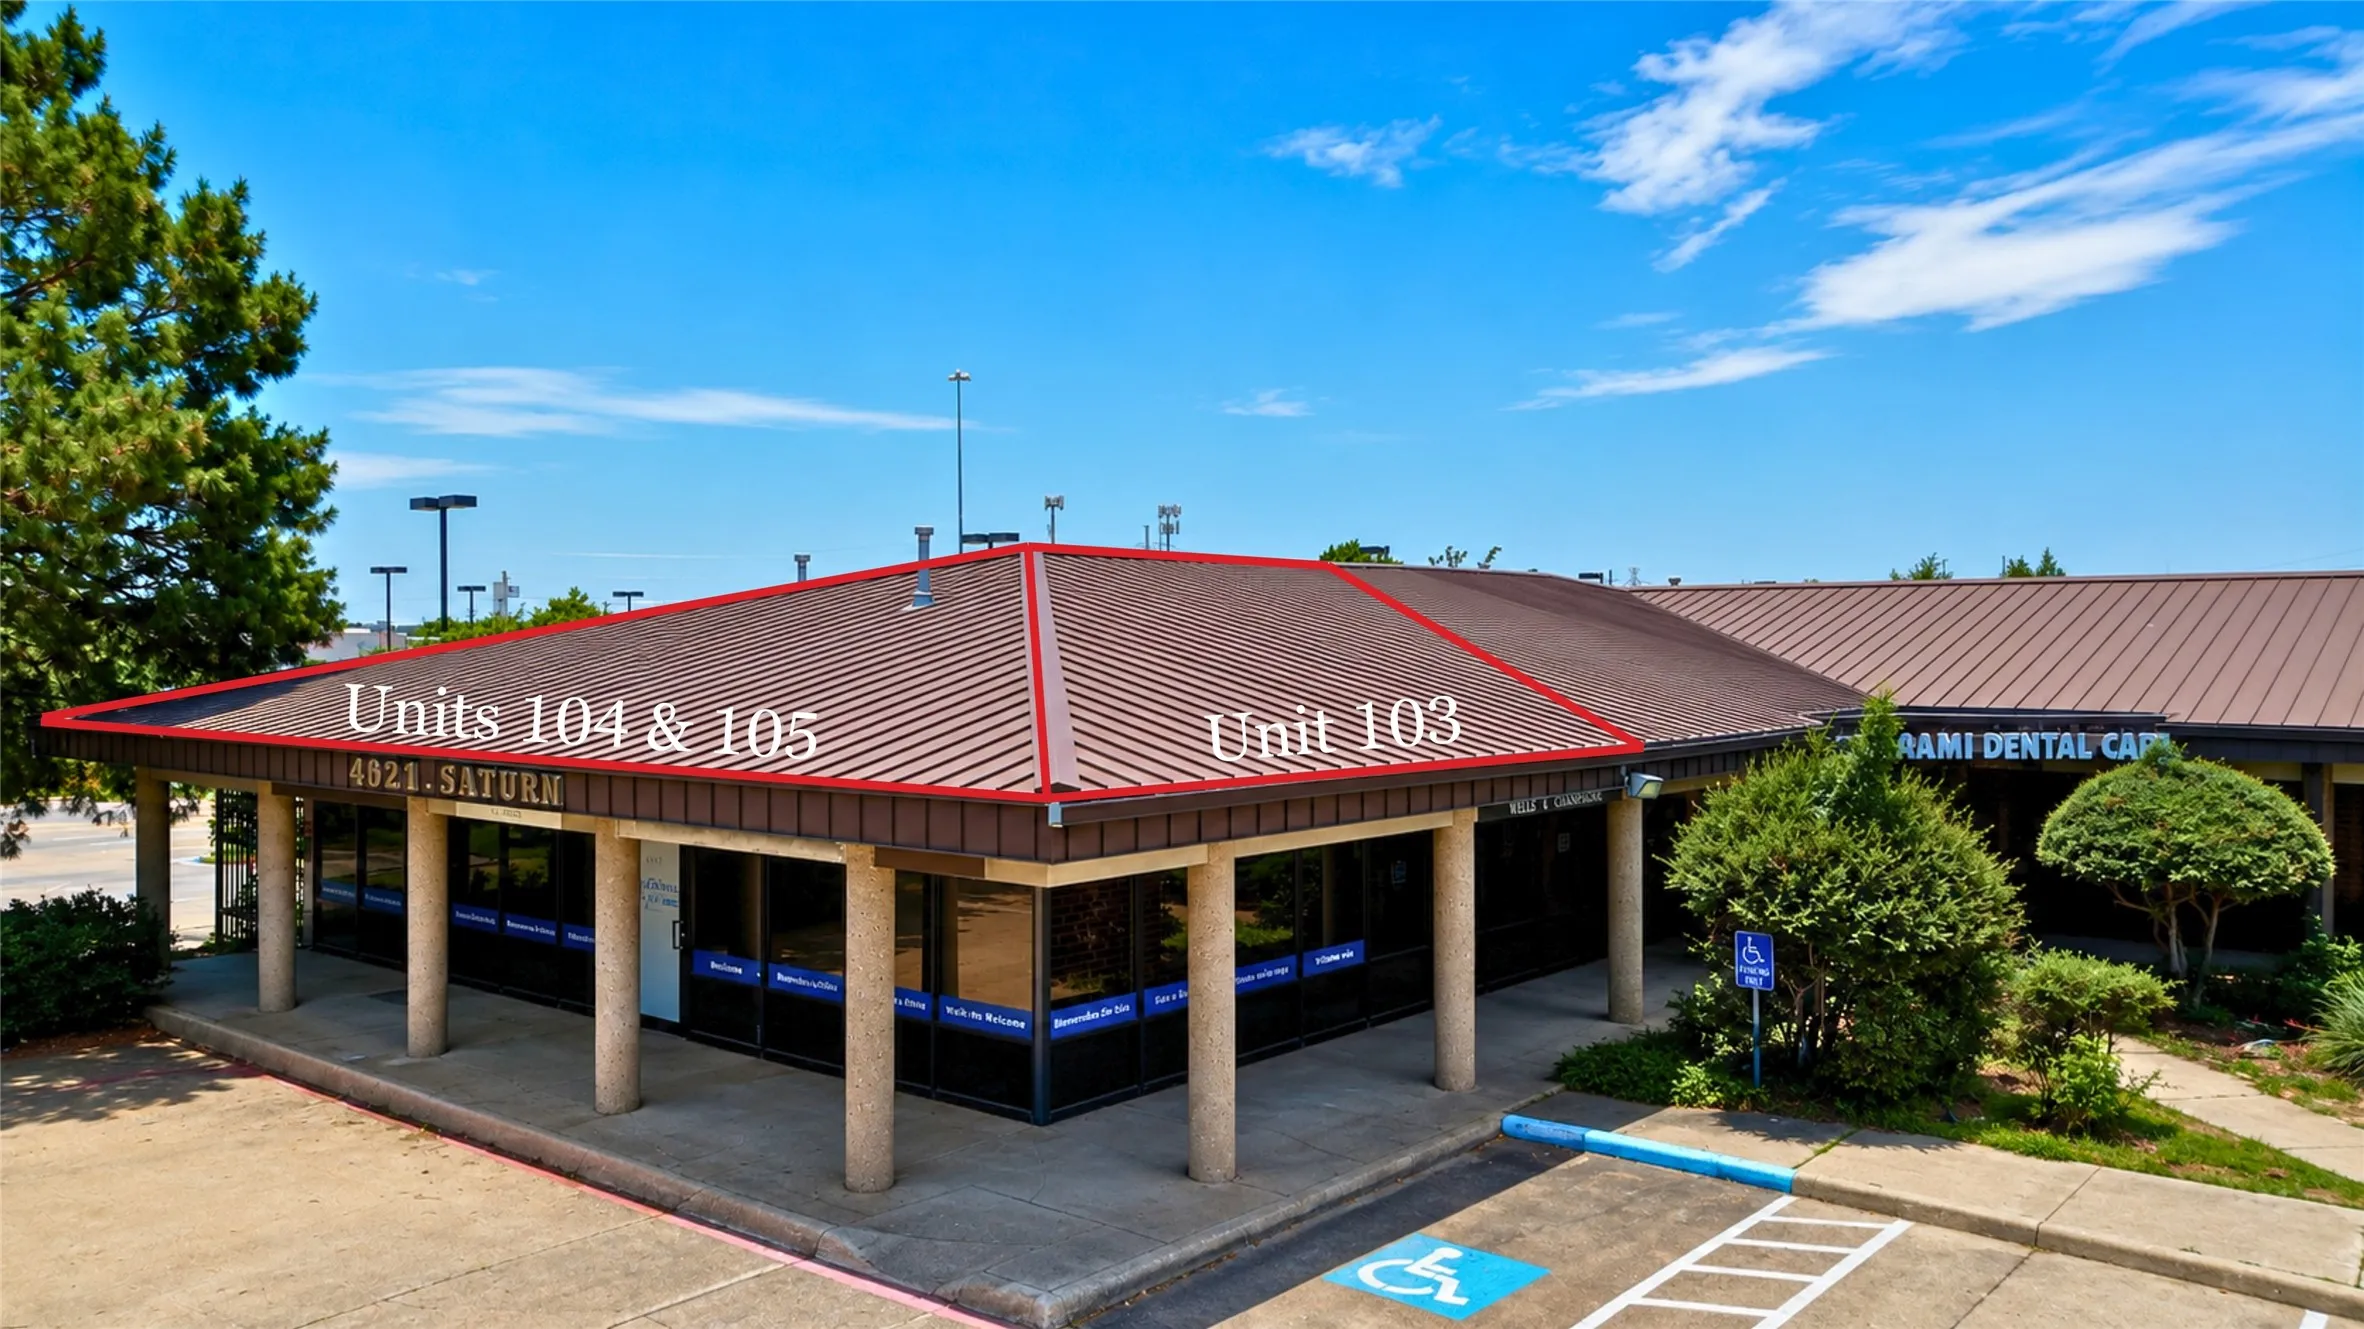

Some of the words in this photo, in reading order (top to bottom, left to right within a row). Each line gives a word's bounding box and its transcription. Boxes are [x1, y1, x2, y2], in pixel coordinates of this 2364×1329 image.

[1897, 732, 1973, 760] RAMI
[1984, 732, 2092, 760] DENTAL
[440, 764, 564, 806] SATURN
